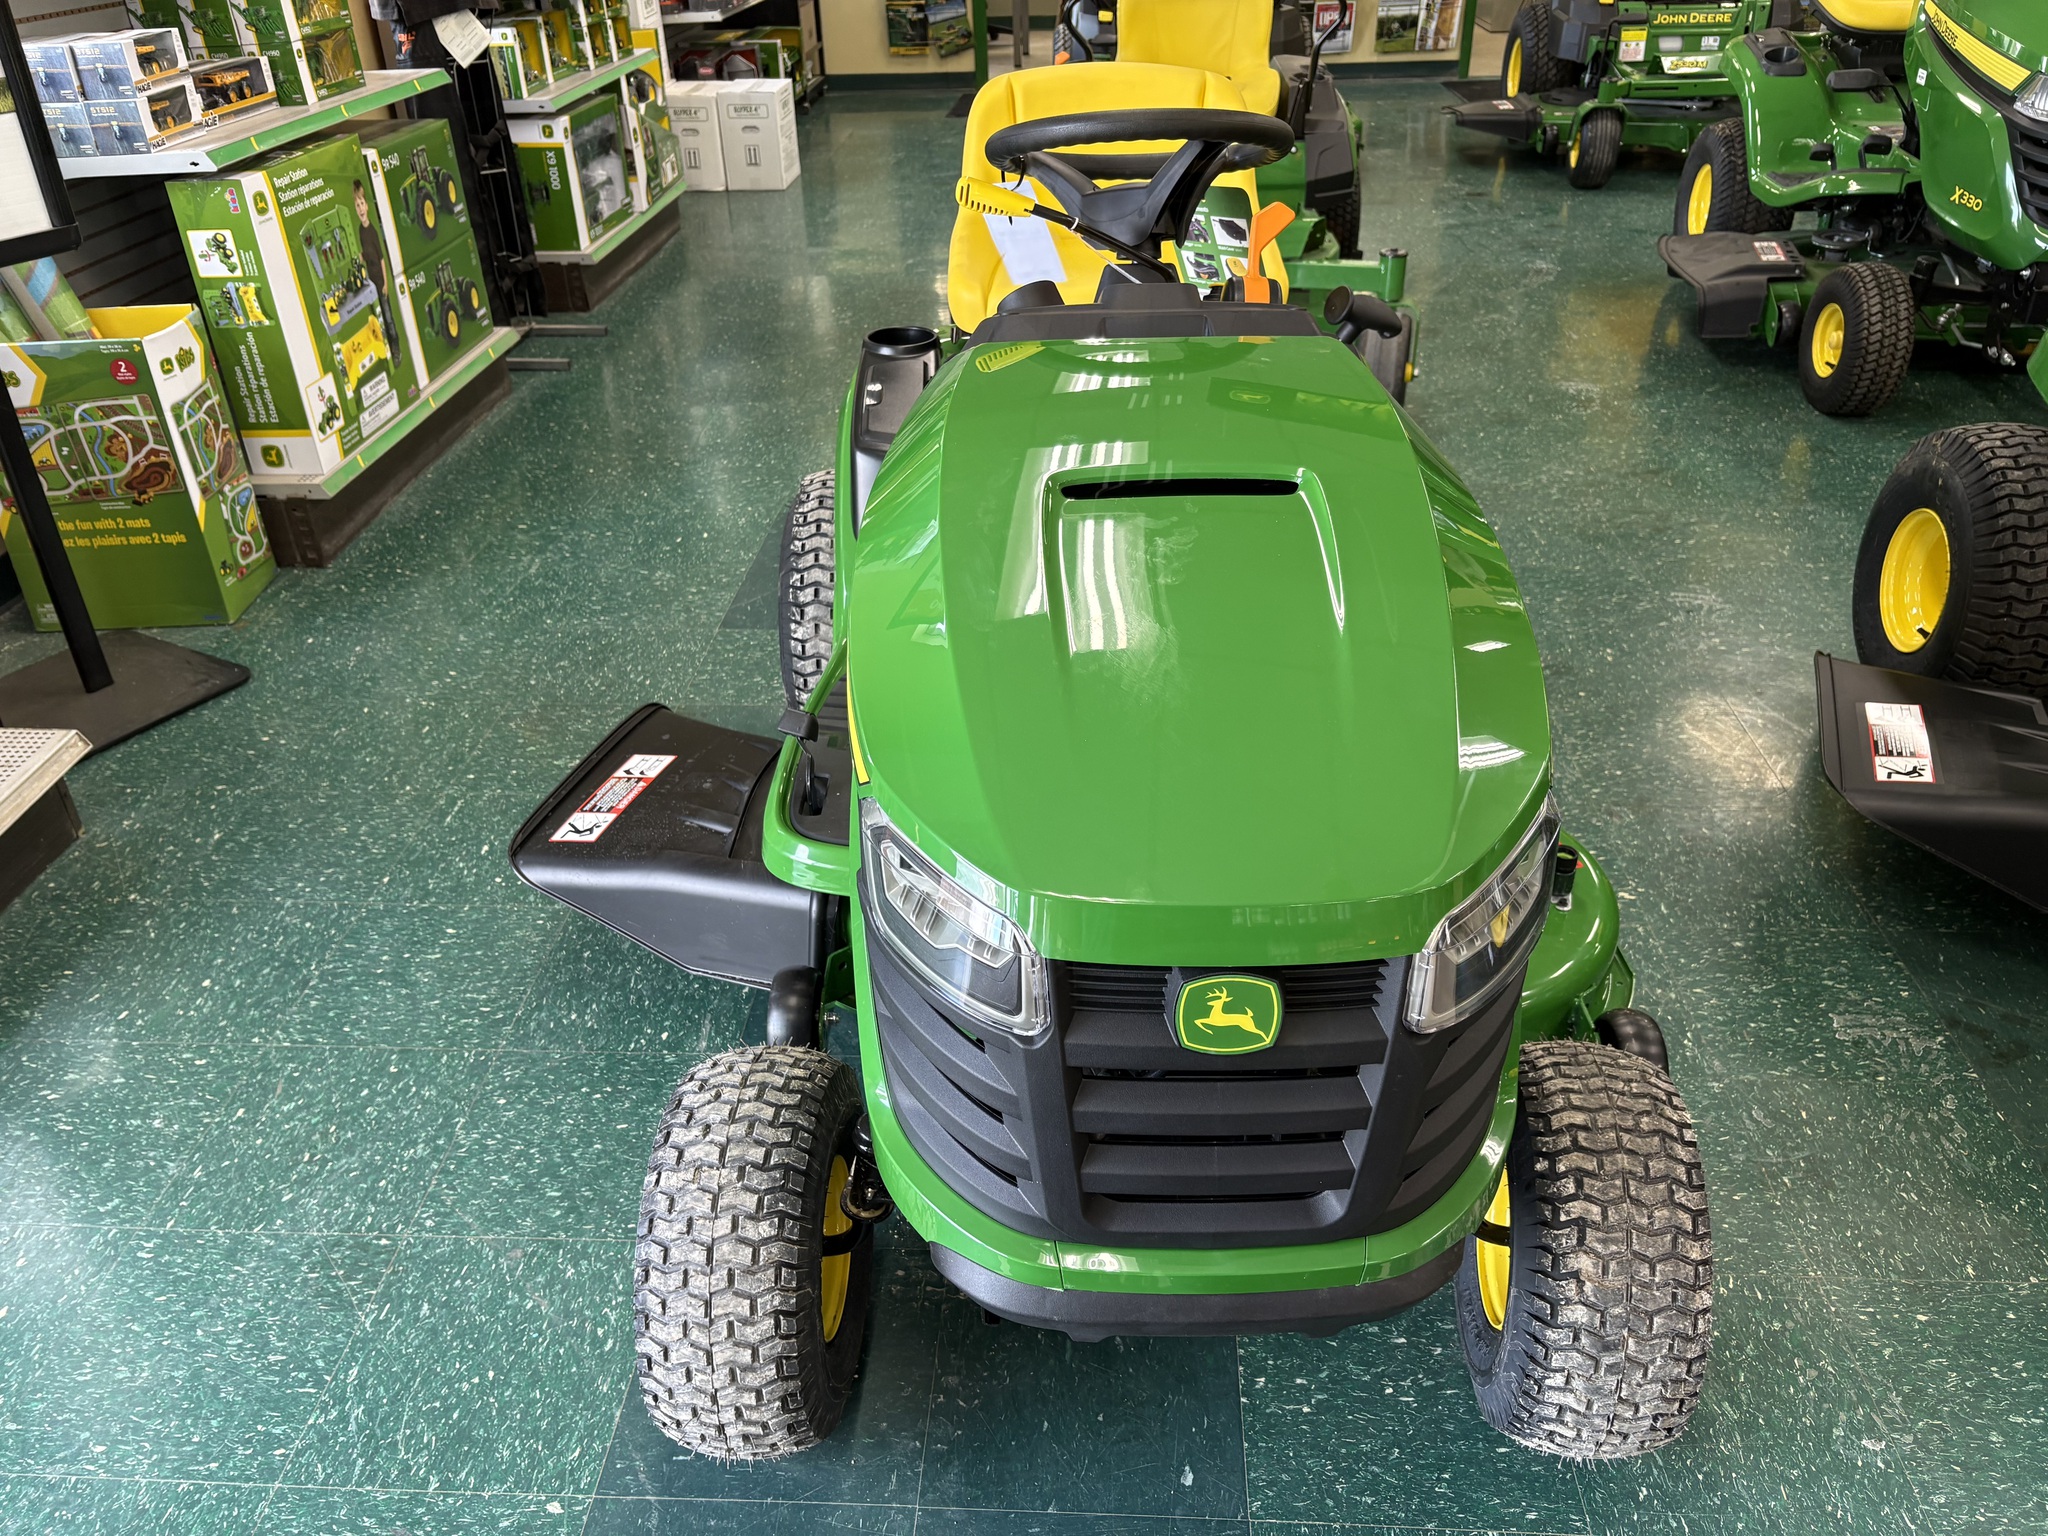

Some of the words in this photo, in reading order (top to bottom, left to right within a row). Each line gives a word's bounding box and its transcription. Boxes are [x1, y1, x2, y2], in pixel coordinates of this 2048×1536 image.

[1653, 13, 1687, 24] JOHN
[1689, 12, 1732, 23] DEERE
[1931, 9, 1946, 32] JOHN
[1941, 21, 1958, 49] DEERE
[204, 115, 218, 129] AGIE
[389, 153, 400, 168] 540
[546, 150, 557, 165] X9
[273, 173, 291, 189] Repair
[289, 168, 308, 182] Station
[549, 166, 561, 190] 1000
[278, 188, 298, 203] Station
[304, 197, 311, 209] de
[1950, 185, 1983, 212] X330
[117, 361, 128, 373] 2
[234, 366, 249, 396] Station
[259, 377, 268, 388] de
[255, 395, 269, 423] Station
[58, 519, 75, 531] the
[75, 519, 93, 530] fun
[95, 518, 117, 530] with
[116, 517, 125, 529] 2
[125, 518, 151, 529] mats
[63, 537, 75, 547] ez
[75, 535, 92, 547] les
[92, 534, 128, 549] plaisirs
[128, 535, 152, 545] avec
[151, 532, 161, 544] 2
[161, 531, 187, 546] tapis
